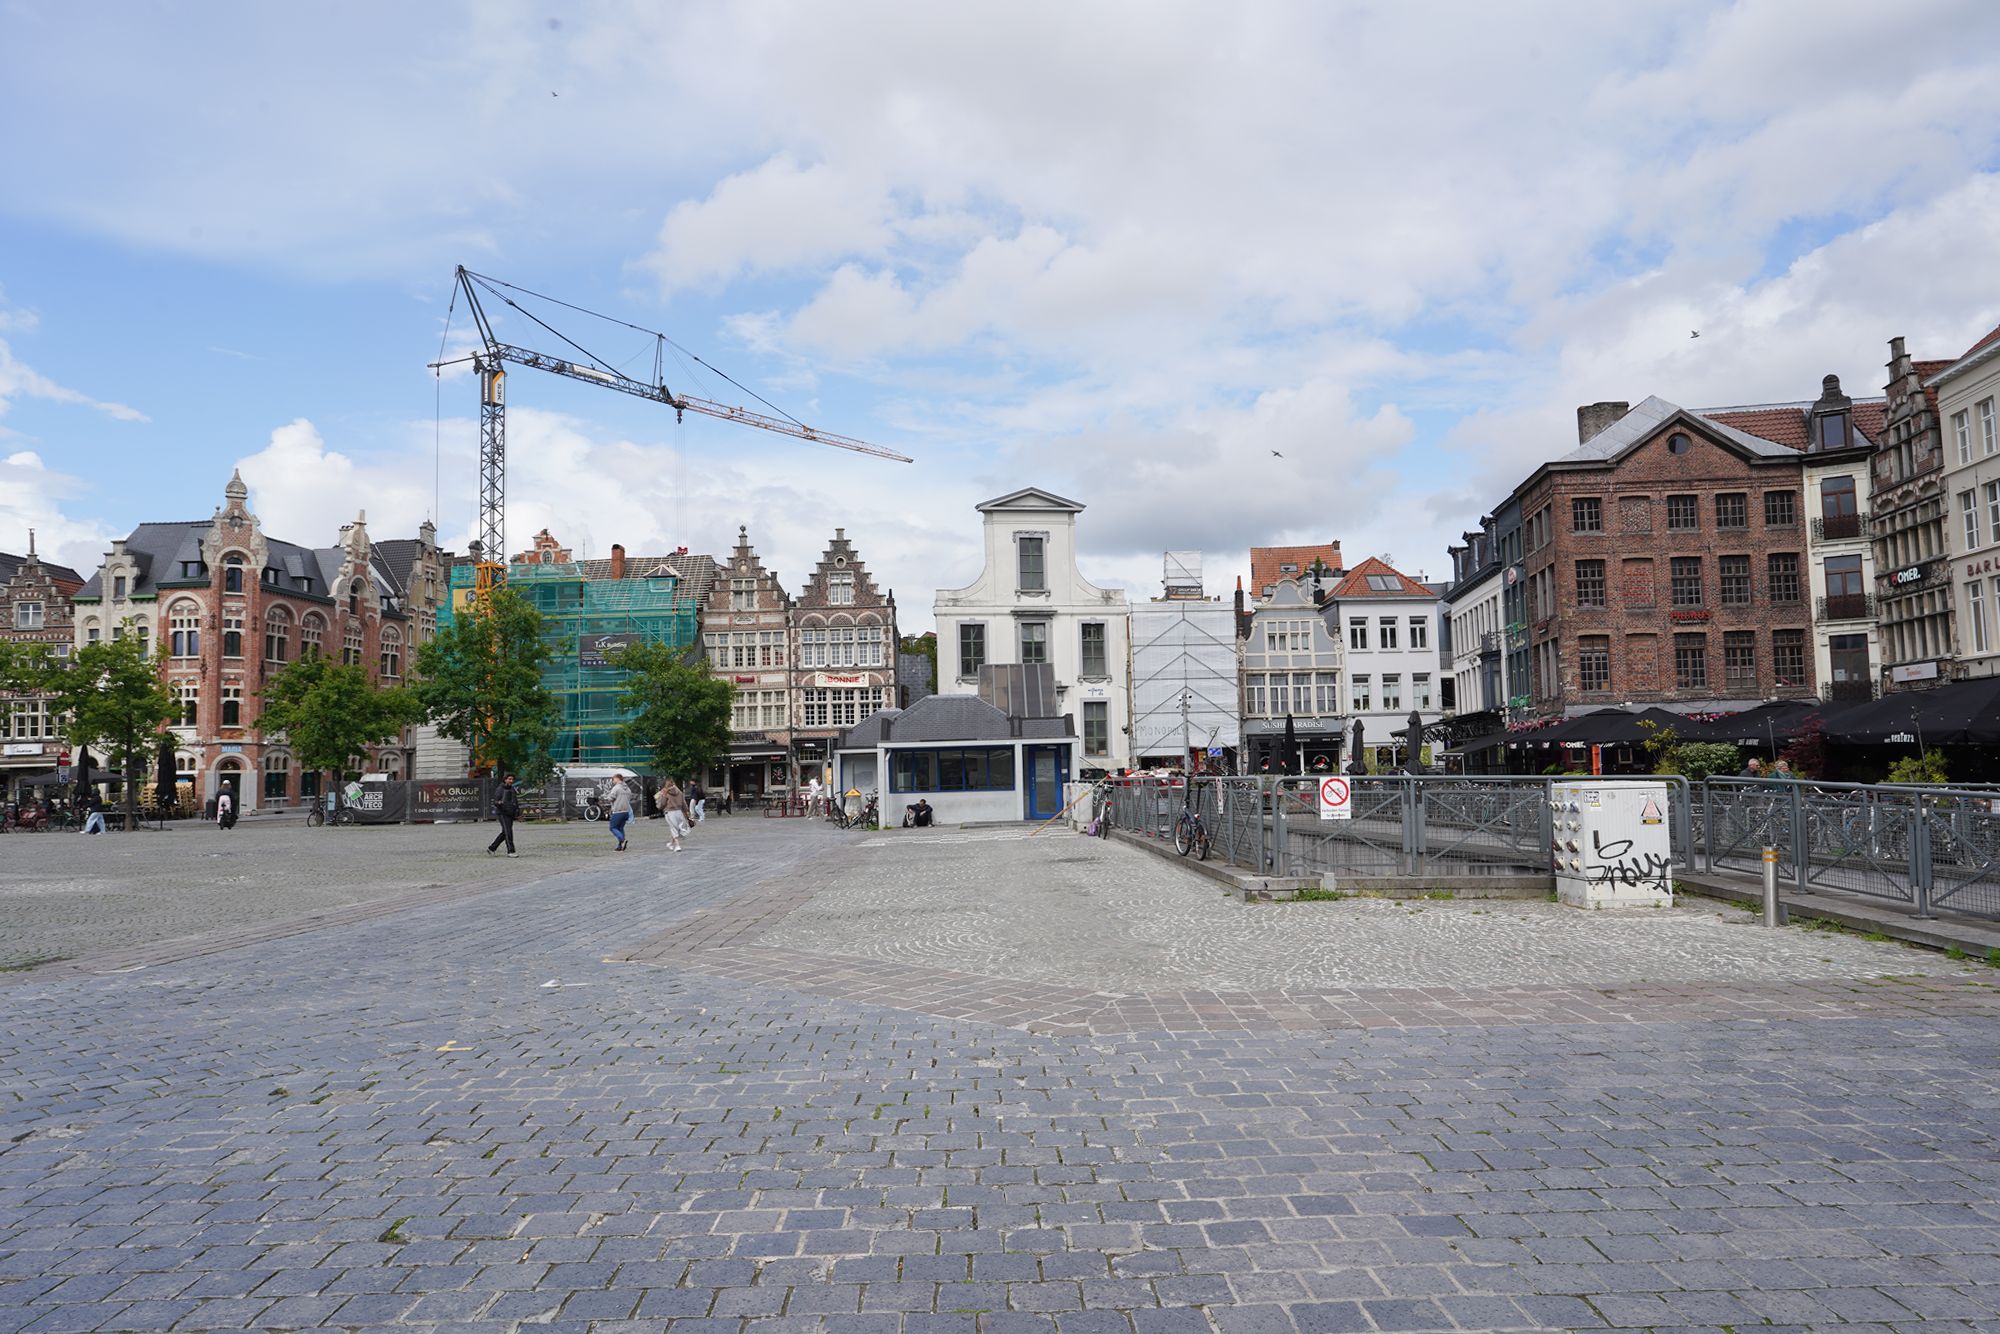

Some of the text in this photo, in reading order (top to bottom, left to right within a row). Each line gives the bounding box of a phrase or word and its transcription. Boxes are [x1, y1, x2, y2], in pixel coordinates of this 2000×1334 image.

[1967, 560, 1992, 577] BAR
[1262, 721, 1285, 729] SUSHI
[448, 787, 479, 797] GROUP
[576, 789, 594, 797] ARCH
